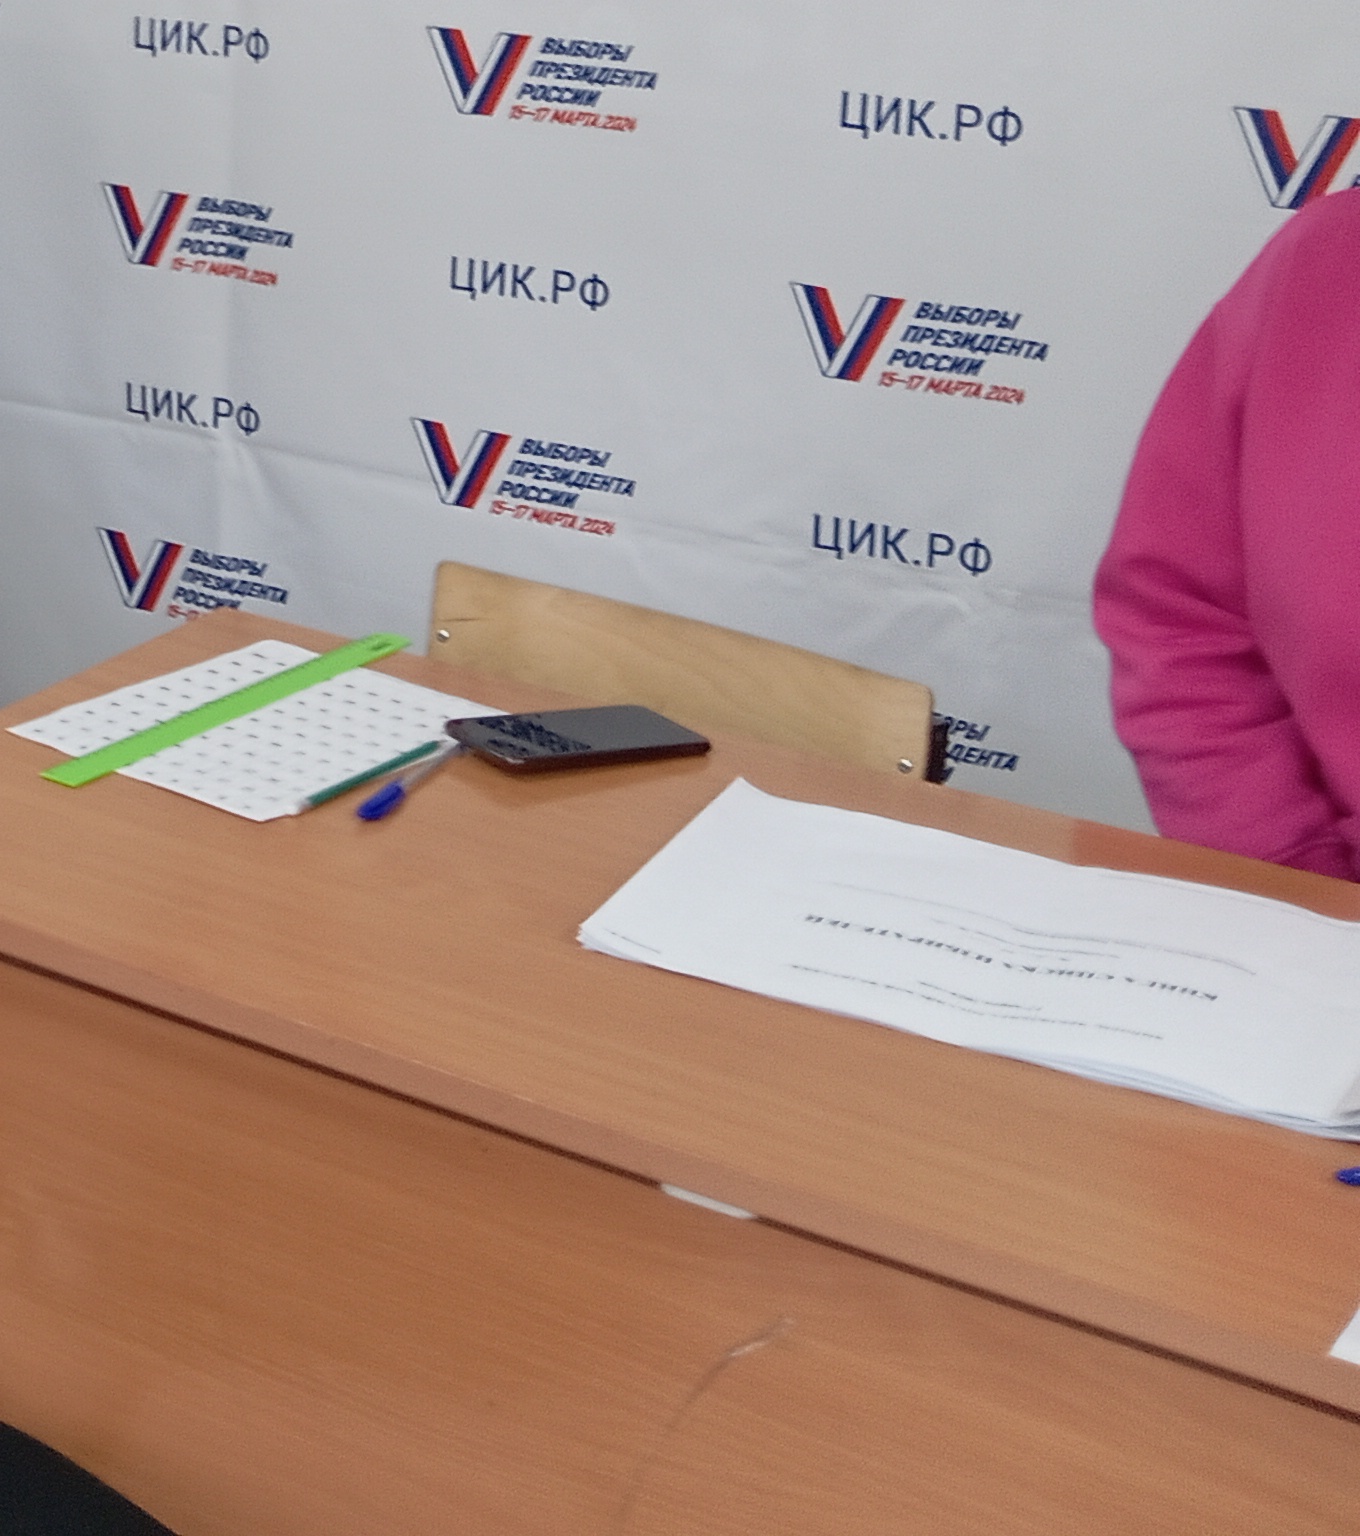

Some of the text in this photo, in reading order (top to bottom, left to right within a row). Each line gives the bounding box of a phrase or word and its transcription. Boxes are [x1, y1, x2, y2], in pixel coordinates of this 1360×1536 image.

[132, 15, 271, 64] ЦИК.РФ
[539, 37, 634, 63] ВЫБОРЫ
[527, 59, 658, 90] ПРЕЗИДЕНТА
[516, 82, 603, 107] РОССИИ
[838, 89, 1024, 148] ЦИК.РФ
[196, 195, 274, 222] ВЫБОРЫ
[186, 216, 294, 247] ПРЕЗИДЕНТА
[177, 236, 250, 261] РОССИИ
[449, 255, 611, 312] ЦИК.РФ
[914, 300, 1022, 331] ВЫБОРЫ
[900, 324, 1050, 361] ПРЕЗИДЕНТА
[887, 347, 985, 377] РОССИИ
[125, 381, 262, 437] ЦИК.РФ
[518, 437, 612, 468] ВЫБОРЫ
[507, 458, 636, 497] ПРЕЗИДЕНТА
[496, 479, 580, 509] РОССИИ
[811, 512, 993, 578] ЦИК.РФ
